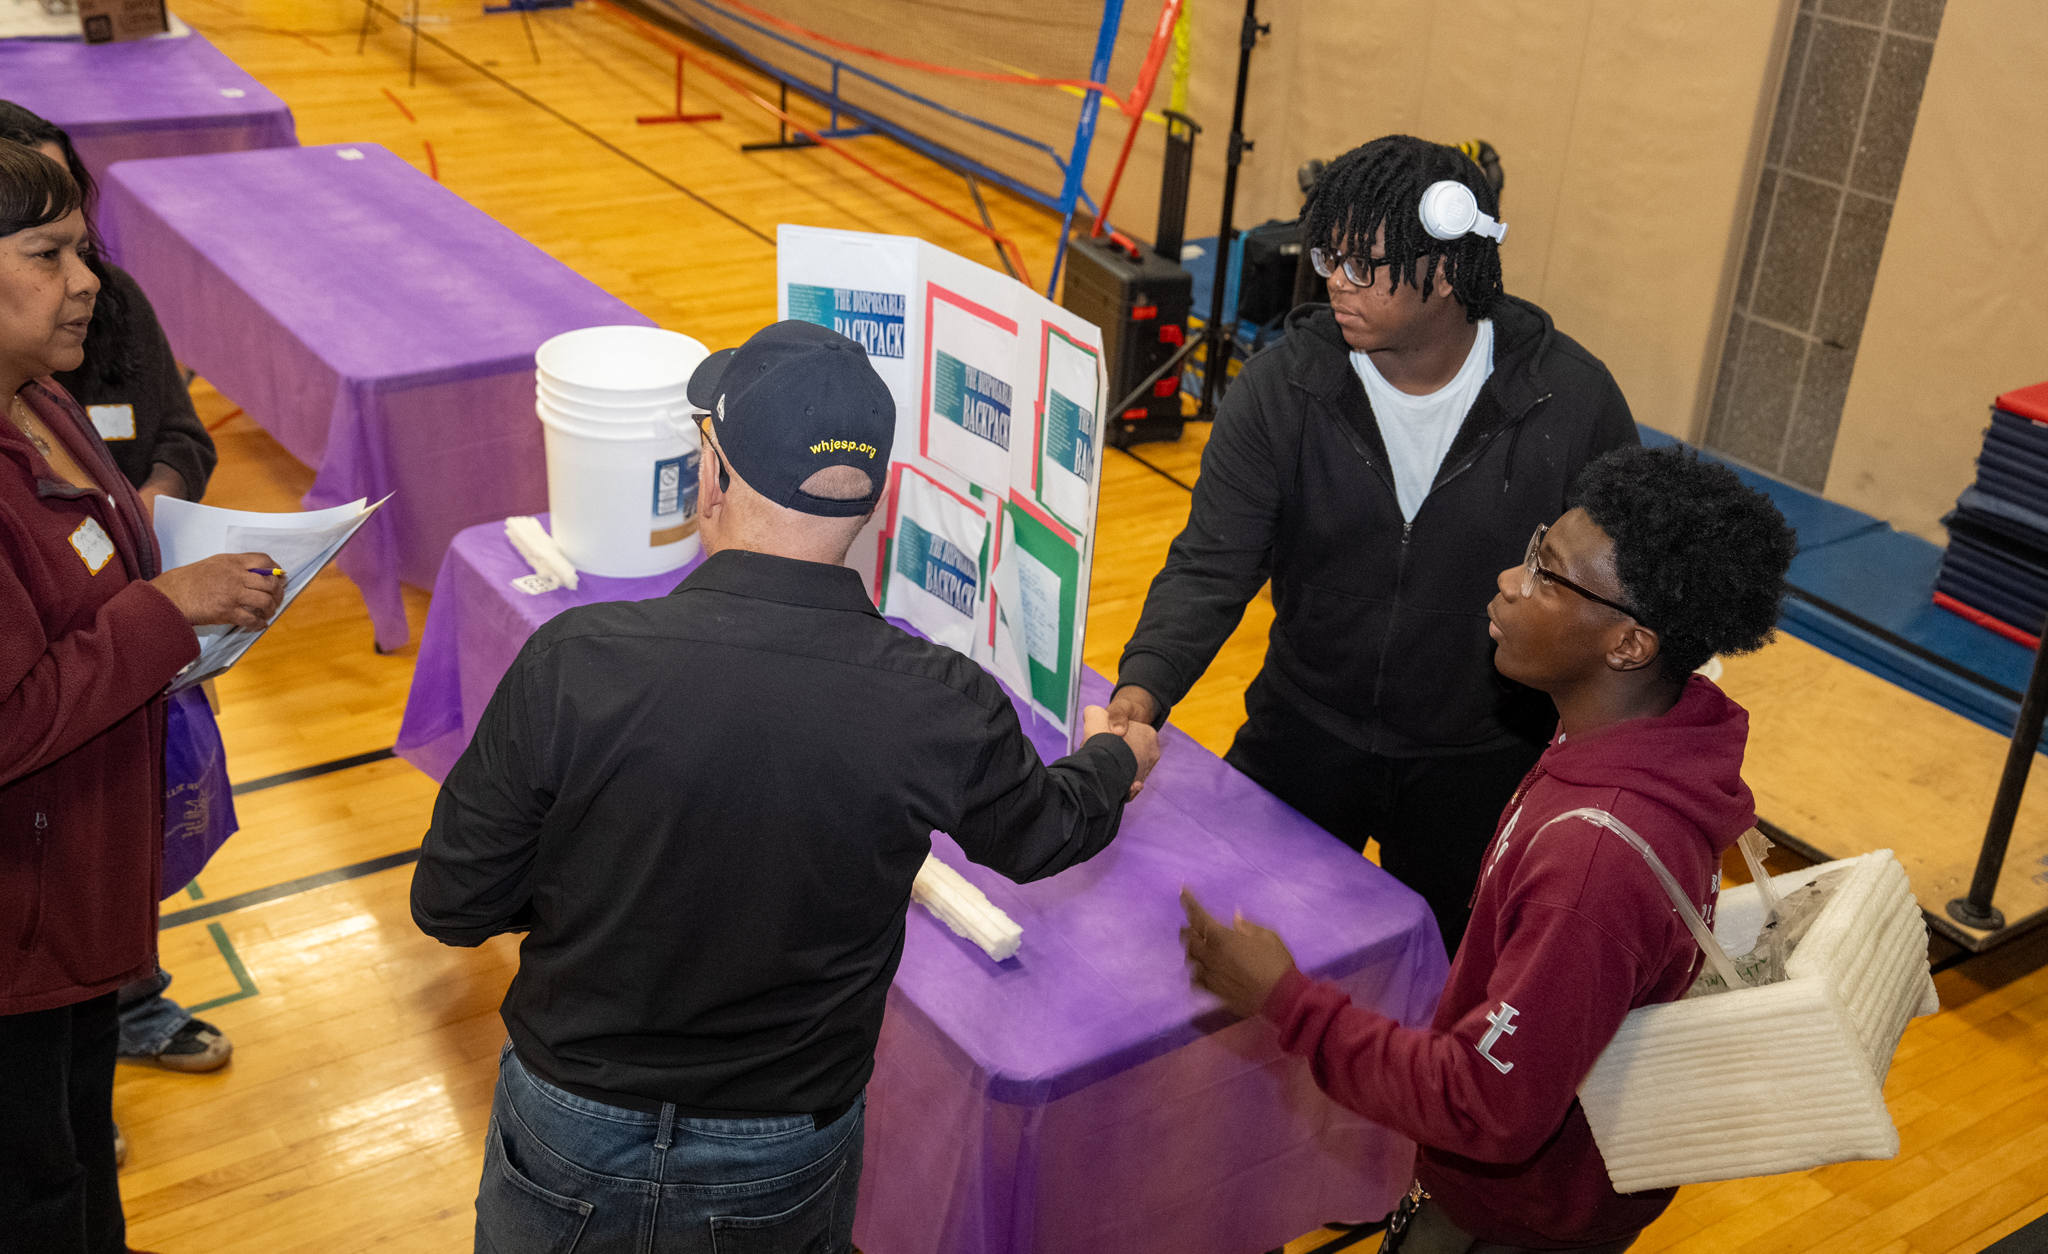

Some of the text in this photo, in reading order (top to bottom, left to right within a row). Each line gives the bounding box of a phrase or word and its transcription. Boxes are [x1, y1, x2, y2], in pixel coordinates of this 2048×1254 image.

[834, 289, 852, 312] THE
[853, 290, 905, 317] DISPOSABLE
[965, 365, 978, 391] THE
[963, 393, 1010, 450] BACKPACK
[809, 439, 877, 459] whjesp.org
[929, 534, 945, 560] THE
[926, 561, 976, 617] BACKPACK
